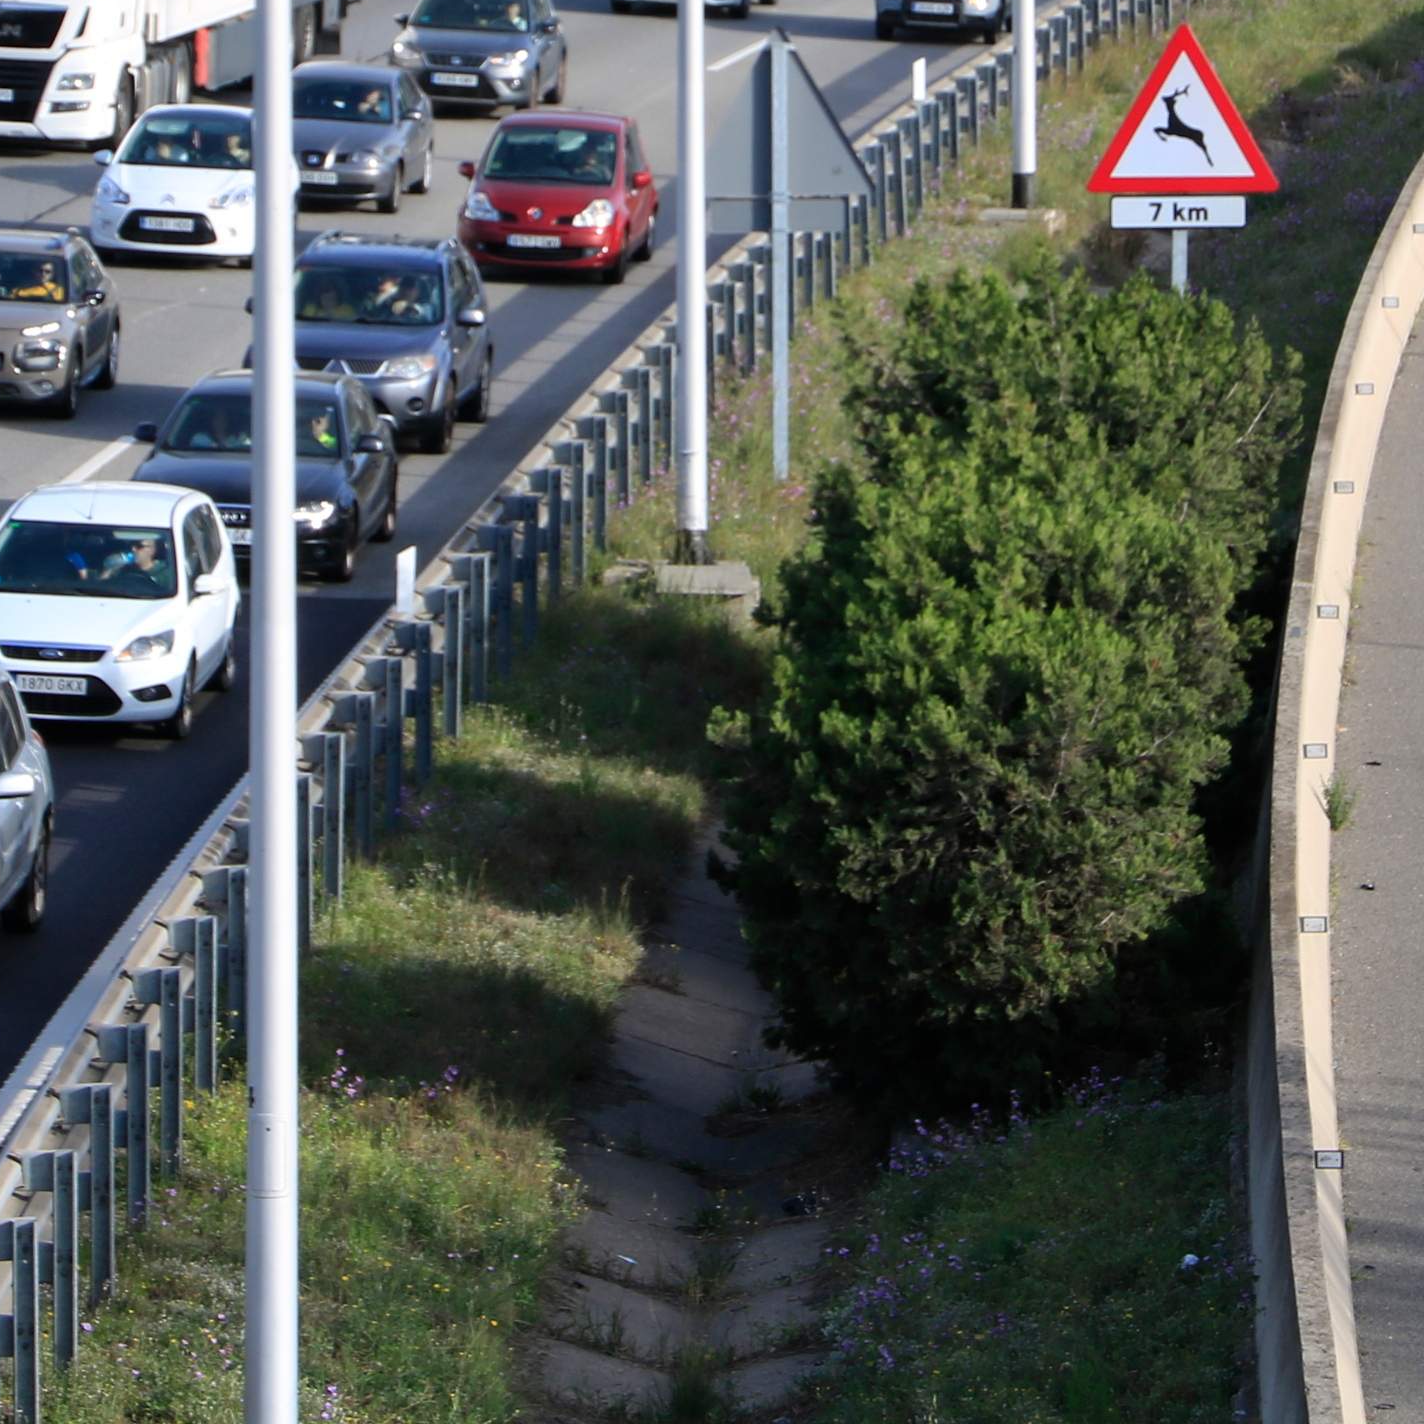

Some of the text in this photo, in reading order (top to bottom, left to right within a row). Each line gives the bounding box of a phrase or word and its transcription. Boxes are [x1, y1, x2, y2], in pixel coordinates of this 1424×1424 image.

[1149, 202, 1208, 221] 7 km
[22, 677, 53, 690] 1870
